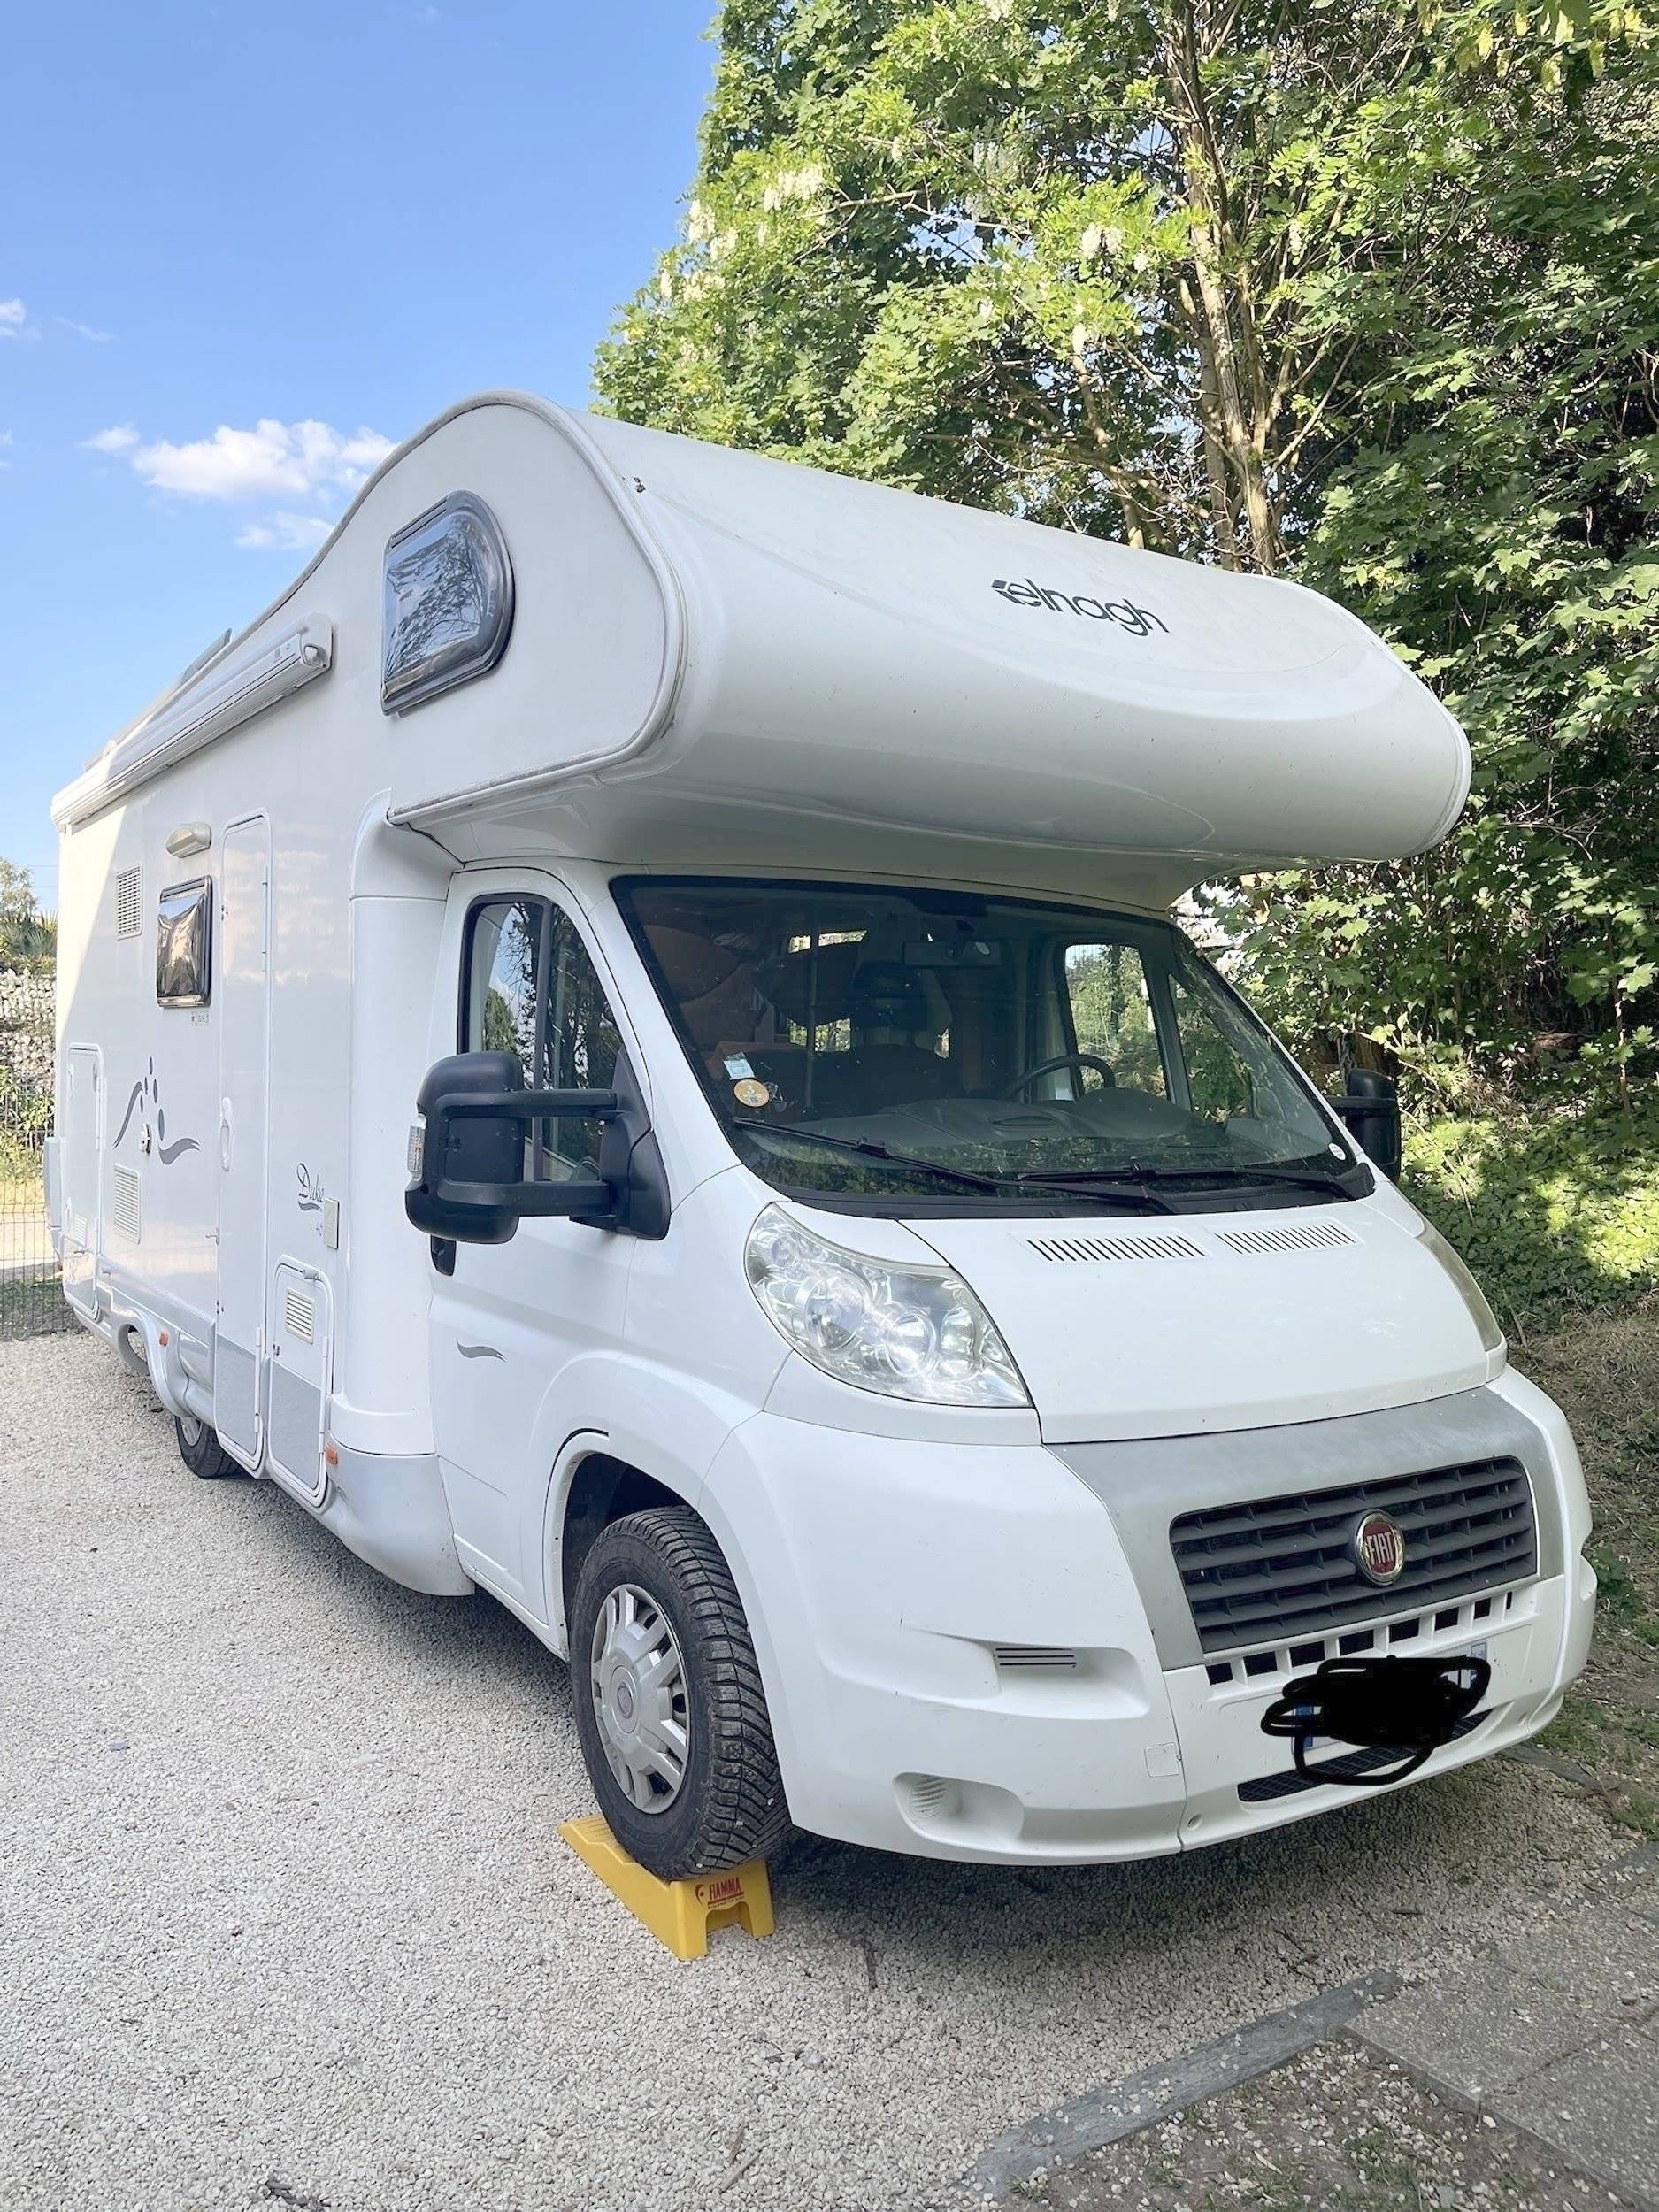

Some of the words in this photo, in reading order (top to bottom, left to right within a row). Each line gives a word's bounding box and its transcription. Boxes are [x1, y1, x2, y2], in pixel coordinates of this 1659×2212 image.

[991, 578, 1170, 636] elnagh
[1366, 1532, 1394, 1565] FIAT
[709, 1877, 741, 1901] FIAMMA
